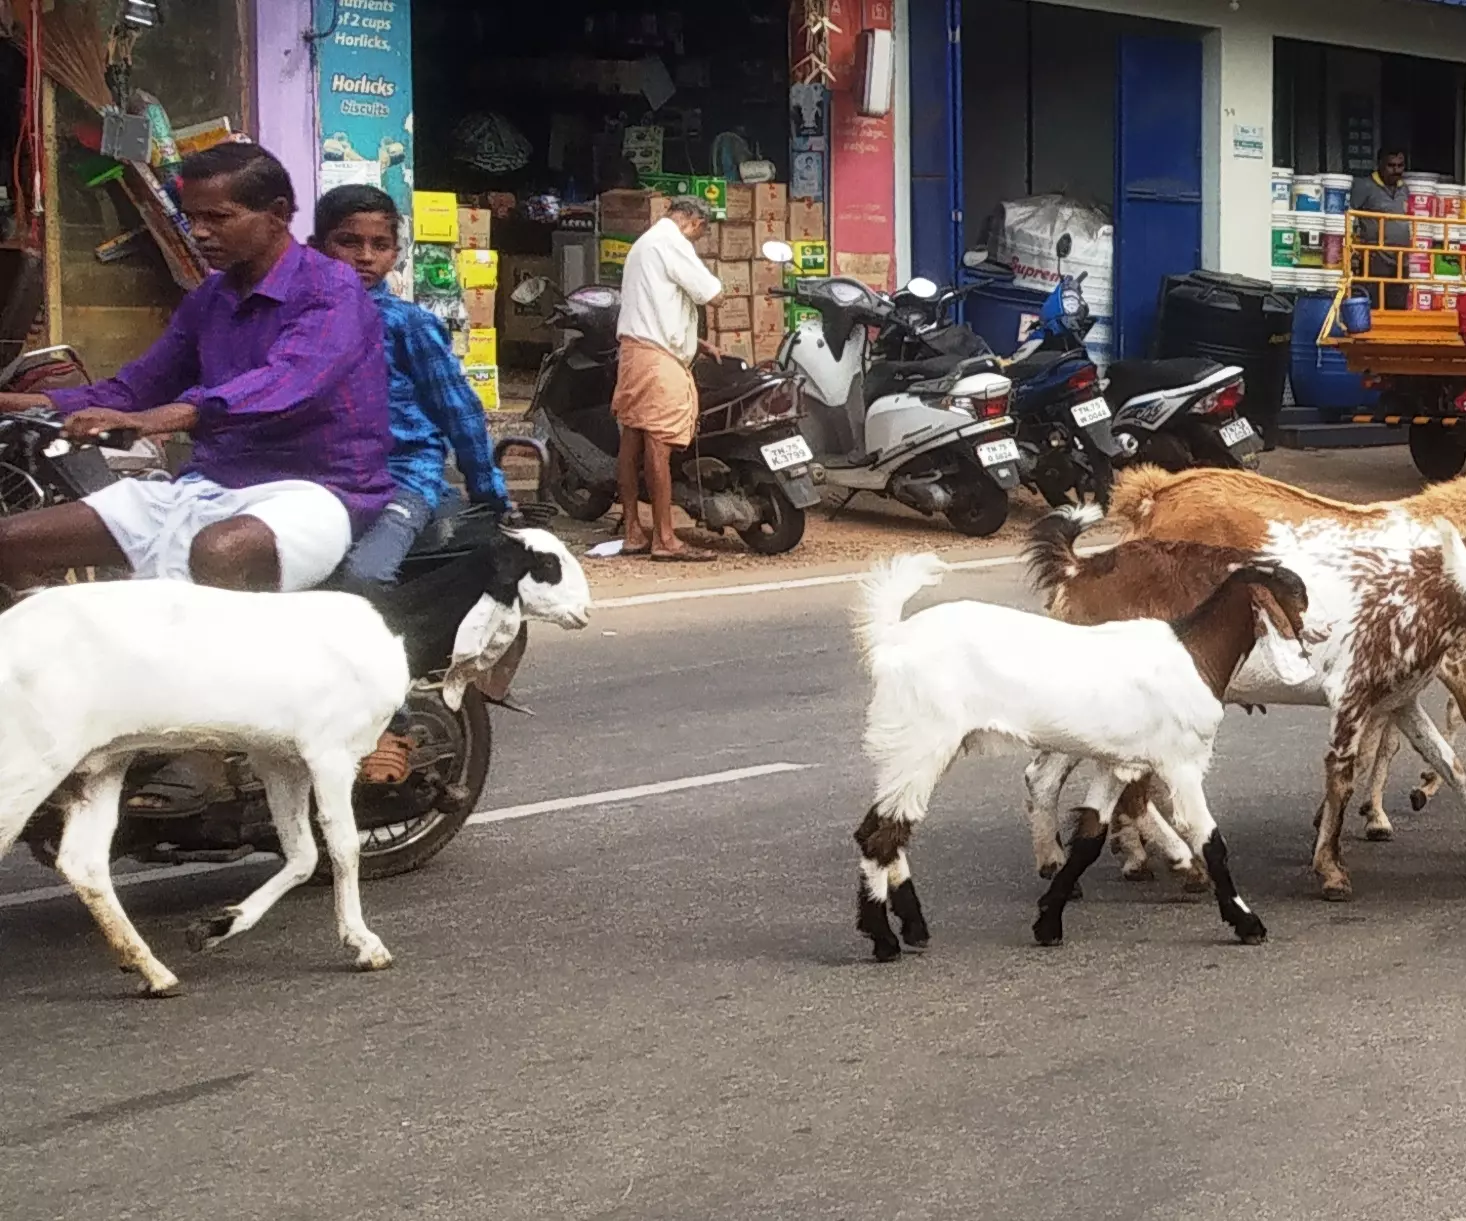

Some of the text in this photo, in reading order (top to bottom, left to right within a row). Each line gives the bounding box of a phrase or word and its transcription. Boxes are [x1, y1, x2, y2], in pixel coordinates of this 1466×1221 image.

[350, 13, 360, 27] 2
[362, 17, 392, 32] cups
[332, 74, 394, 96] Horlicks
[341, 100, 388, 115] biscuits
[1011, 255, 1061, 282] Suprem
